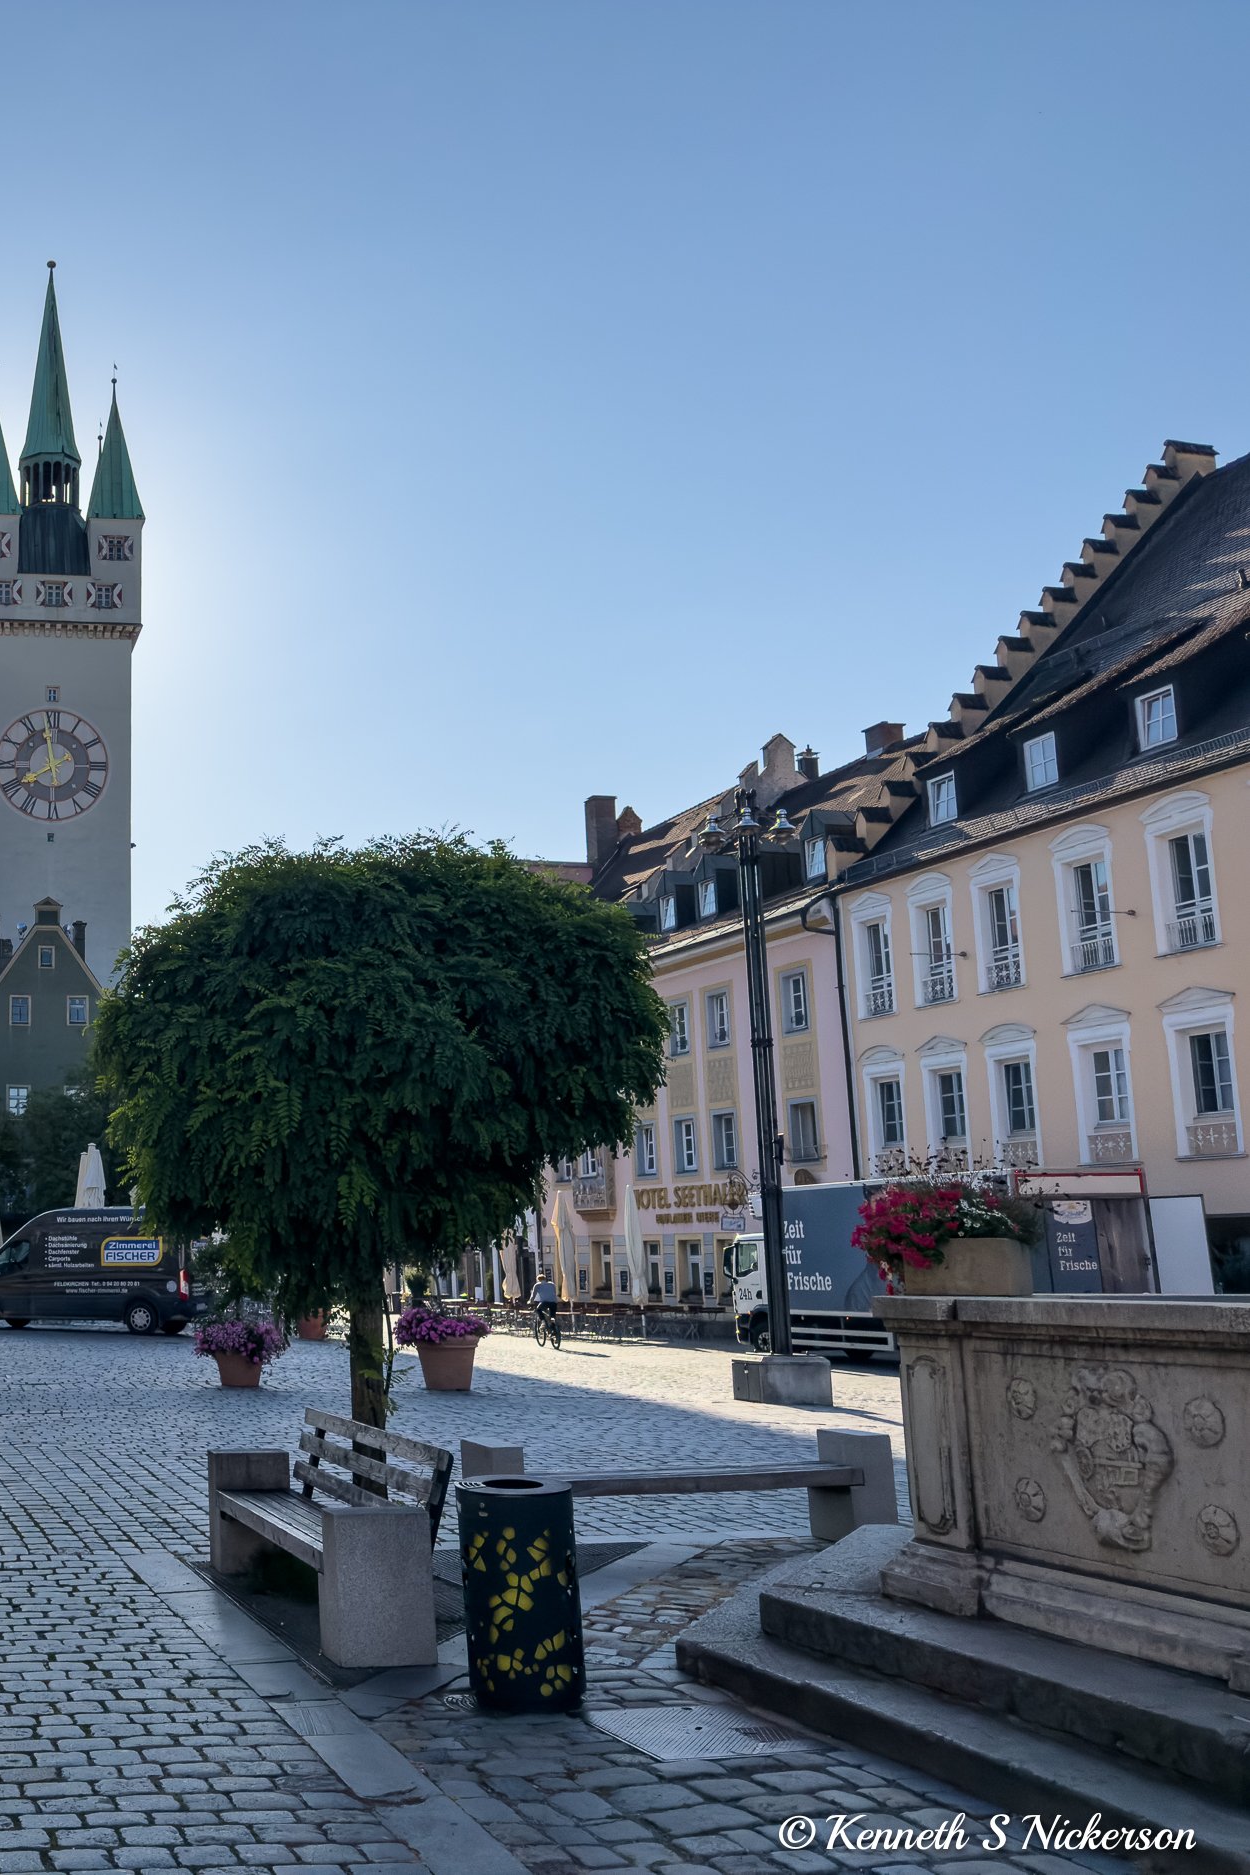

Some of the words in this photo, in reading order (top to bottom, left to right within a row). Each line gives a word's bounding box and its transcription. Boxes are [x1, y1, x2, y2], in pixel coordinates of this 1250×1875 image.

[1056, 1232, 1076, 1243] Zeit
[108, 1241, 156, 1250] Zimmerei
[105, 1251, 156, 1261] FISCHER
[1058, 1246, 1073, 1257] für
[1059, 1260, 1098, 1271] Frische
[787, 1271, 833, 1291] Frische
[738, 1288, 753, 1300] 24h
